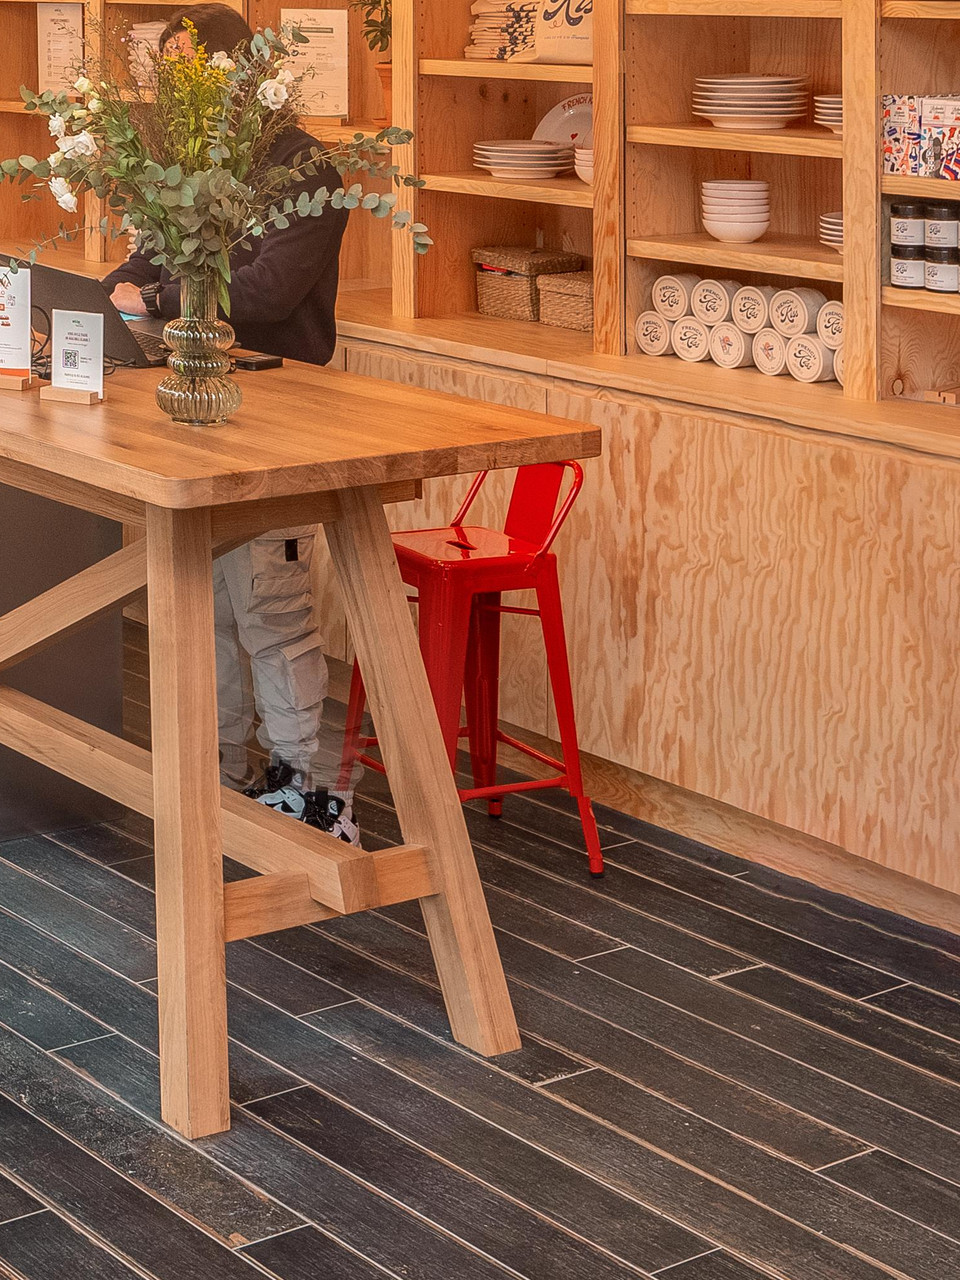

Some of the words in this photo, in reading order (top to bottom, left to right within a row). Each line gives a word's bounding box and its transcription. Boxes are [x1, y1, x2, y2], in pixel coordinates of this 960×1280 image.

[661, 291, 680, 308] Kiss
[699, 294, 718, 312] Kiss
[702, 288, 722, 302] FRENCH
[741, 296, 761, 307] FRENCH
[740, 301, 759, 320] Kiss
[775, 300, 794, 313] FRENCH
[780, 304, 799, 324] Kiss
[642, 320, 662, 329] FRENCH
[681, 326, 703, 336] FRENCH
[824, 316, 843, 336] Kiss
[642, 326, 661, 343] Kiss
[680, 331, 700, 349] Kiss
[793, 349, 812, 370] Kiss
[797, 343, 817, 360] FRENCH
